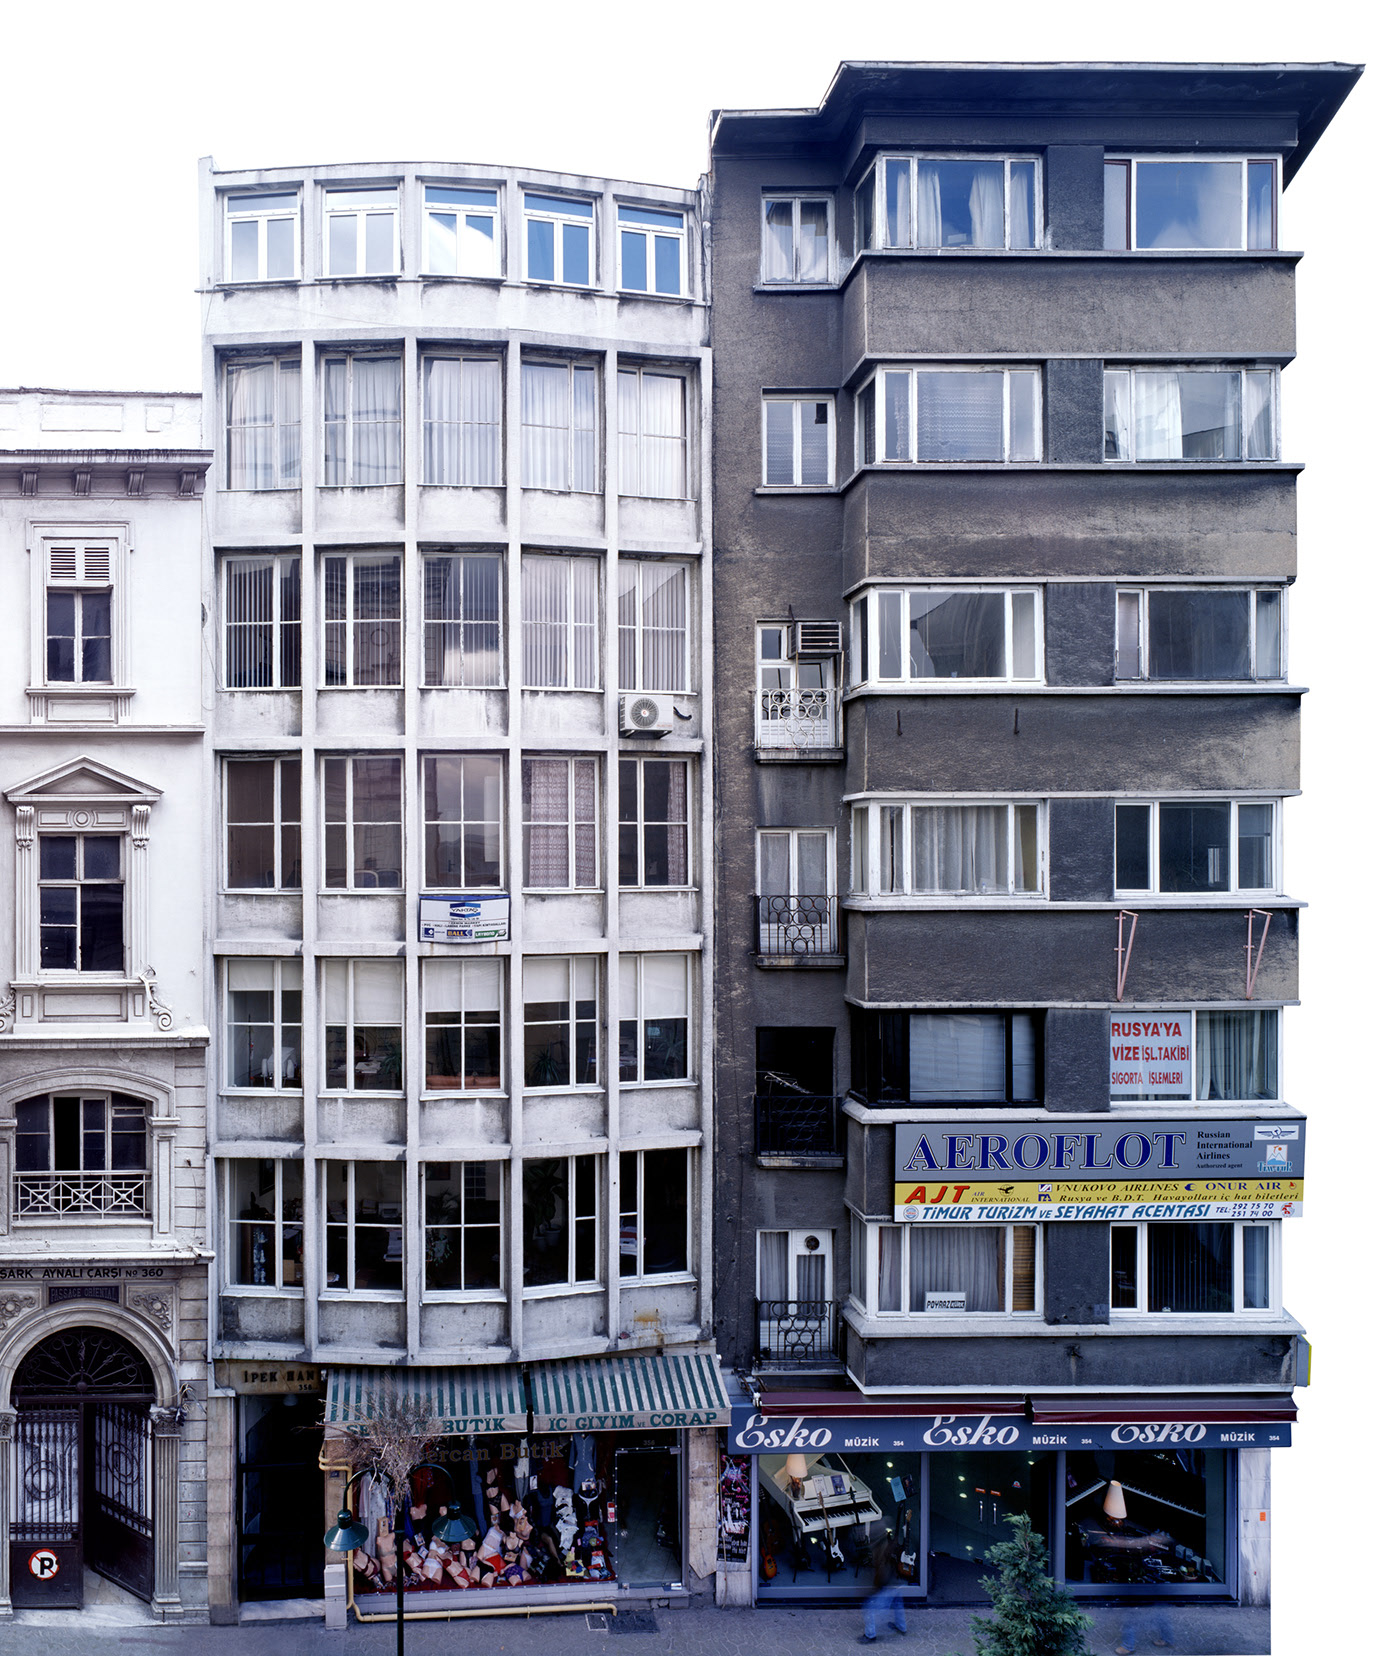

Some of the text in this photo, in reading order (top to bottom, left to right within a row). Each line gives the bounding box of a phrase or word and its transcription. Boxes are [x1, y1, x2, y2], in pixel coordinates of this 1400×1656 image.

[1111, 1022, 1182, 1037] RUSYA'YA
[1112, 1043, 1140, 1061] VİZE
[1148, 1070, 1183, 1086] İŞLEMLERİ
[1197, 1131, 1231, 1139] Russian
[903, 1132, 1187, 1171] AEROFLOT
[1197, 1141, 1253, 1149] International
[1197, 1152, 1231, 1160] Airlines
[1056, 1183, 1180, 1192] VNUKOVO AIRLINES
[1205, 1182, 1282, 1191] ONUR AIR
[904, 1185, 971, 1204] AJT
[1059, 1195, 1092, 1204] Rusya
[1112, 1194, 1145, 1202] B.D.T.
[1152, 1194, 1217, 1203] Havayolları
[1255, 1192, 1299, 1201] biletleri
[1055, 1205, 1129, 1219] SEYAHAT
[1132, 1204, 1211, 1218] ACENTASI
[0, 1268, 33, 1279] ŞARK
[42, 1268, 83, 1278] AYNALI
[87, 1267, 121, 1279] ÇARŞI
[141, 1268, 164, 1277] 360
[346, 1420, 428, 1437] SEN
[735, 1413, 833, 1449] Esko
[844, 1436, 880, 1448] MÜZİK
[922, 1416, 1020, 1447] Esko
[1032, 1433, 1068, 1445] MÜZİK
[1220, 1431, 1256, 1443] MÜZİK
[500, 1441, 564, 1460] Butik
